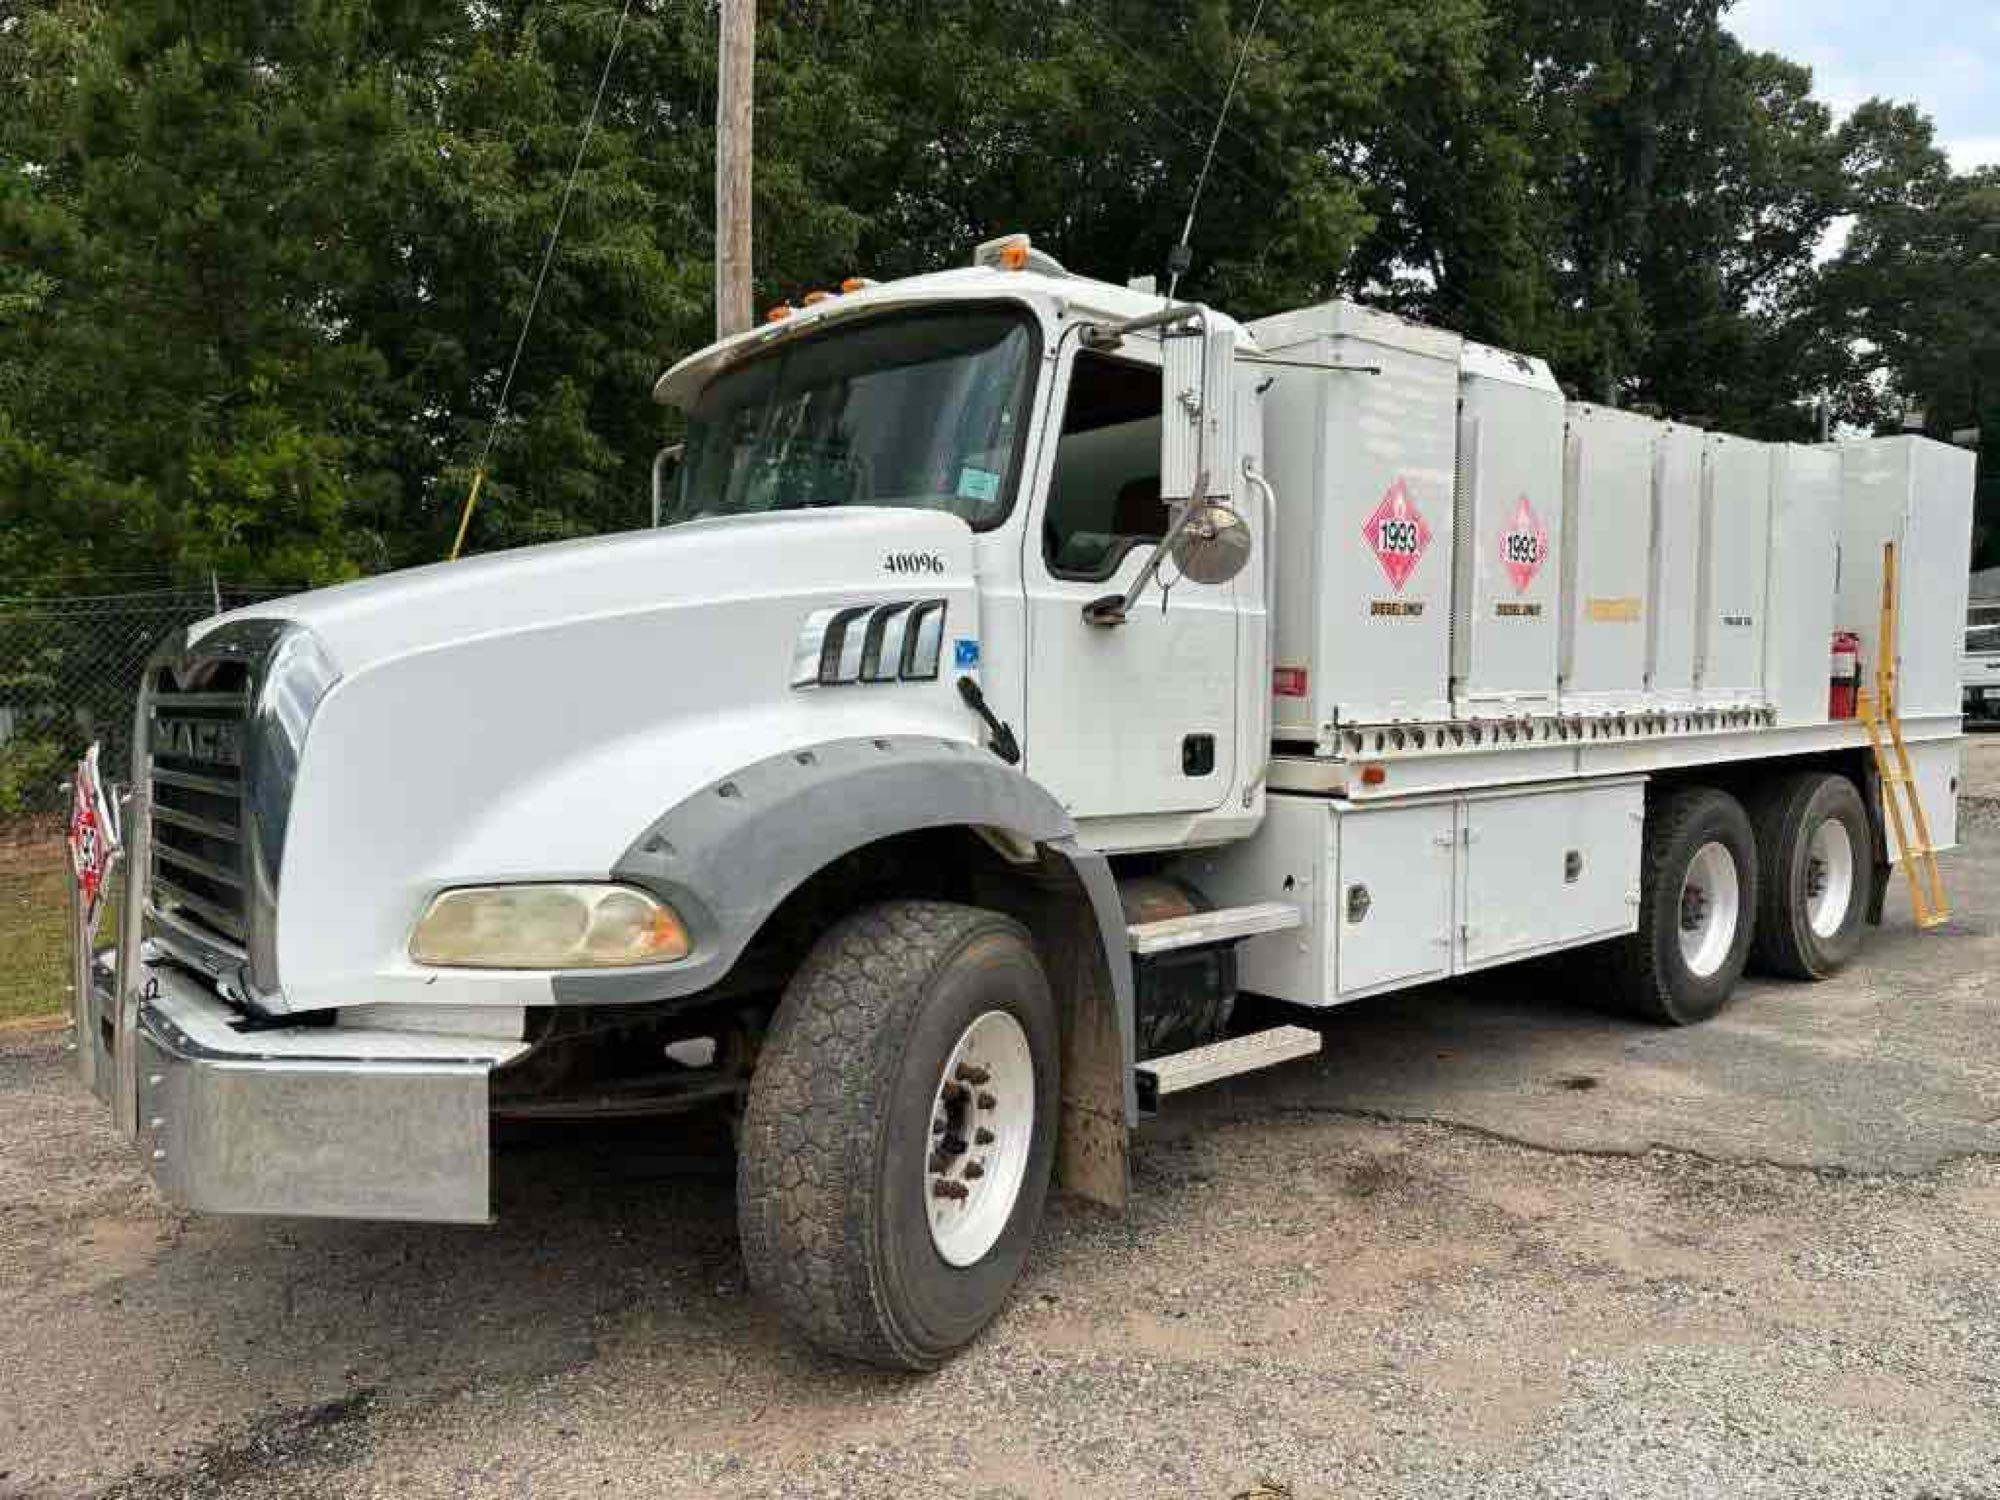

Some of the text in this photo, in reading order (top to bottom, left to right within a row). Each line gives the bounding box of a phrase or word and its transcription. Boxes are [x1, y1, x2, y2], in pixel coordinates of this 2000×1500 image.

[1382, 522, 1417, 553] 1993
[1508, 534, 1537, 563] 1993
[884, 552, 944, 575] 40096
